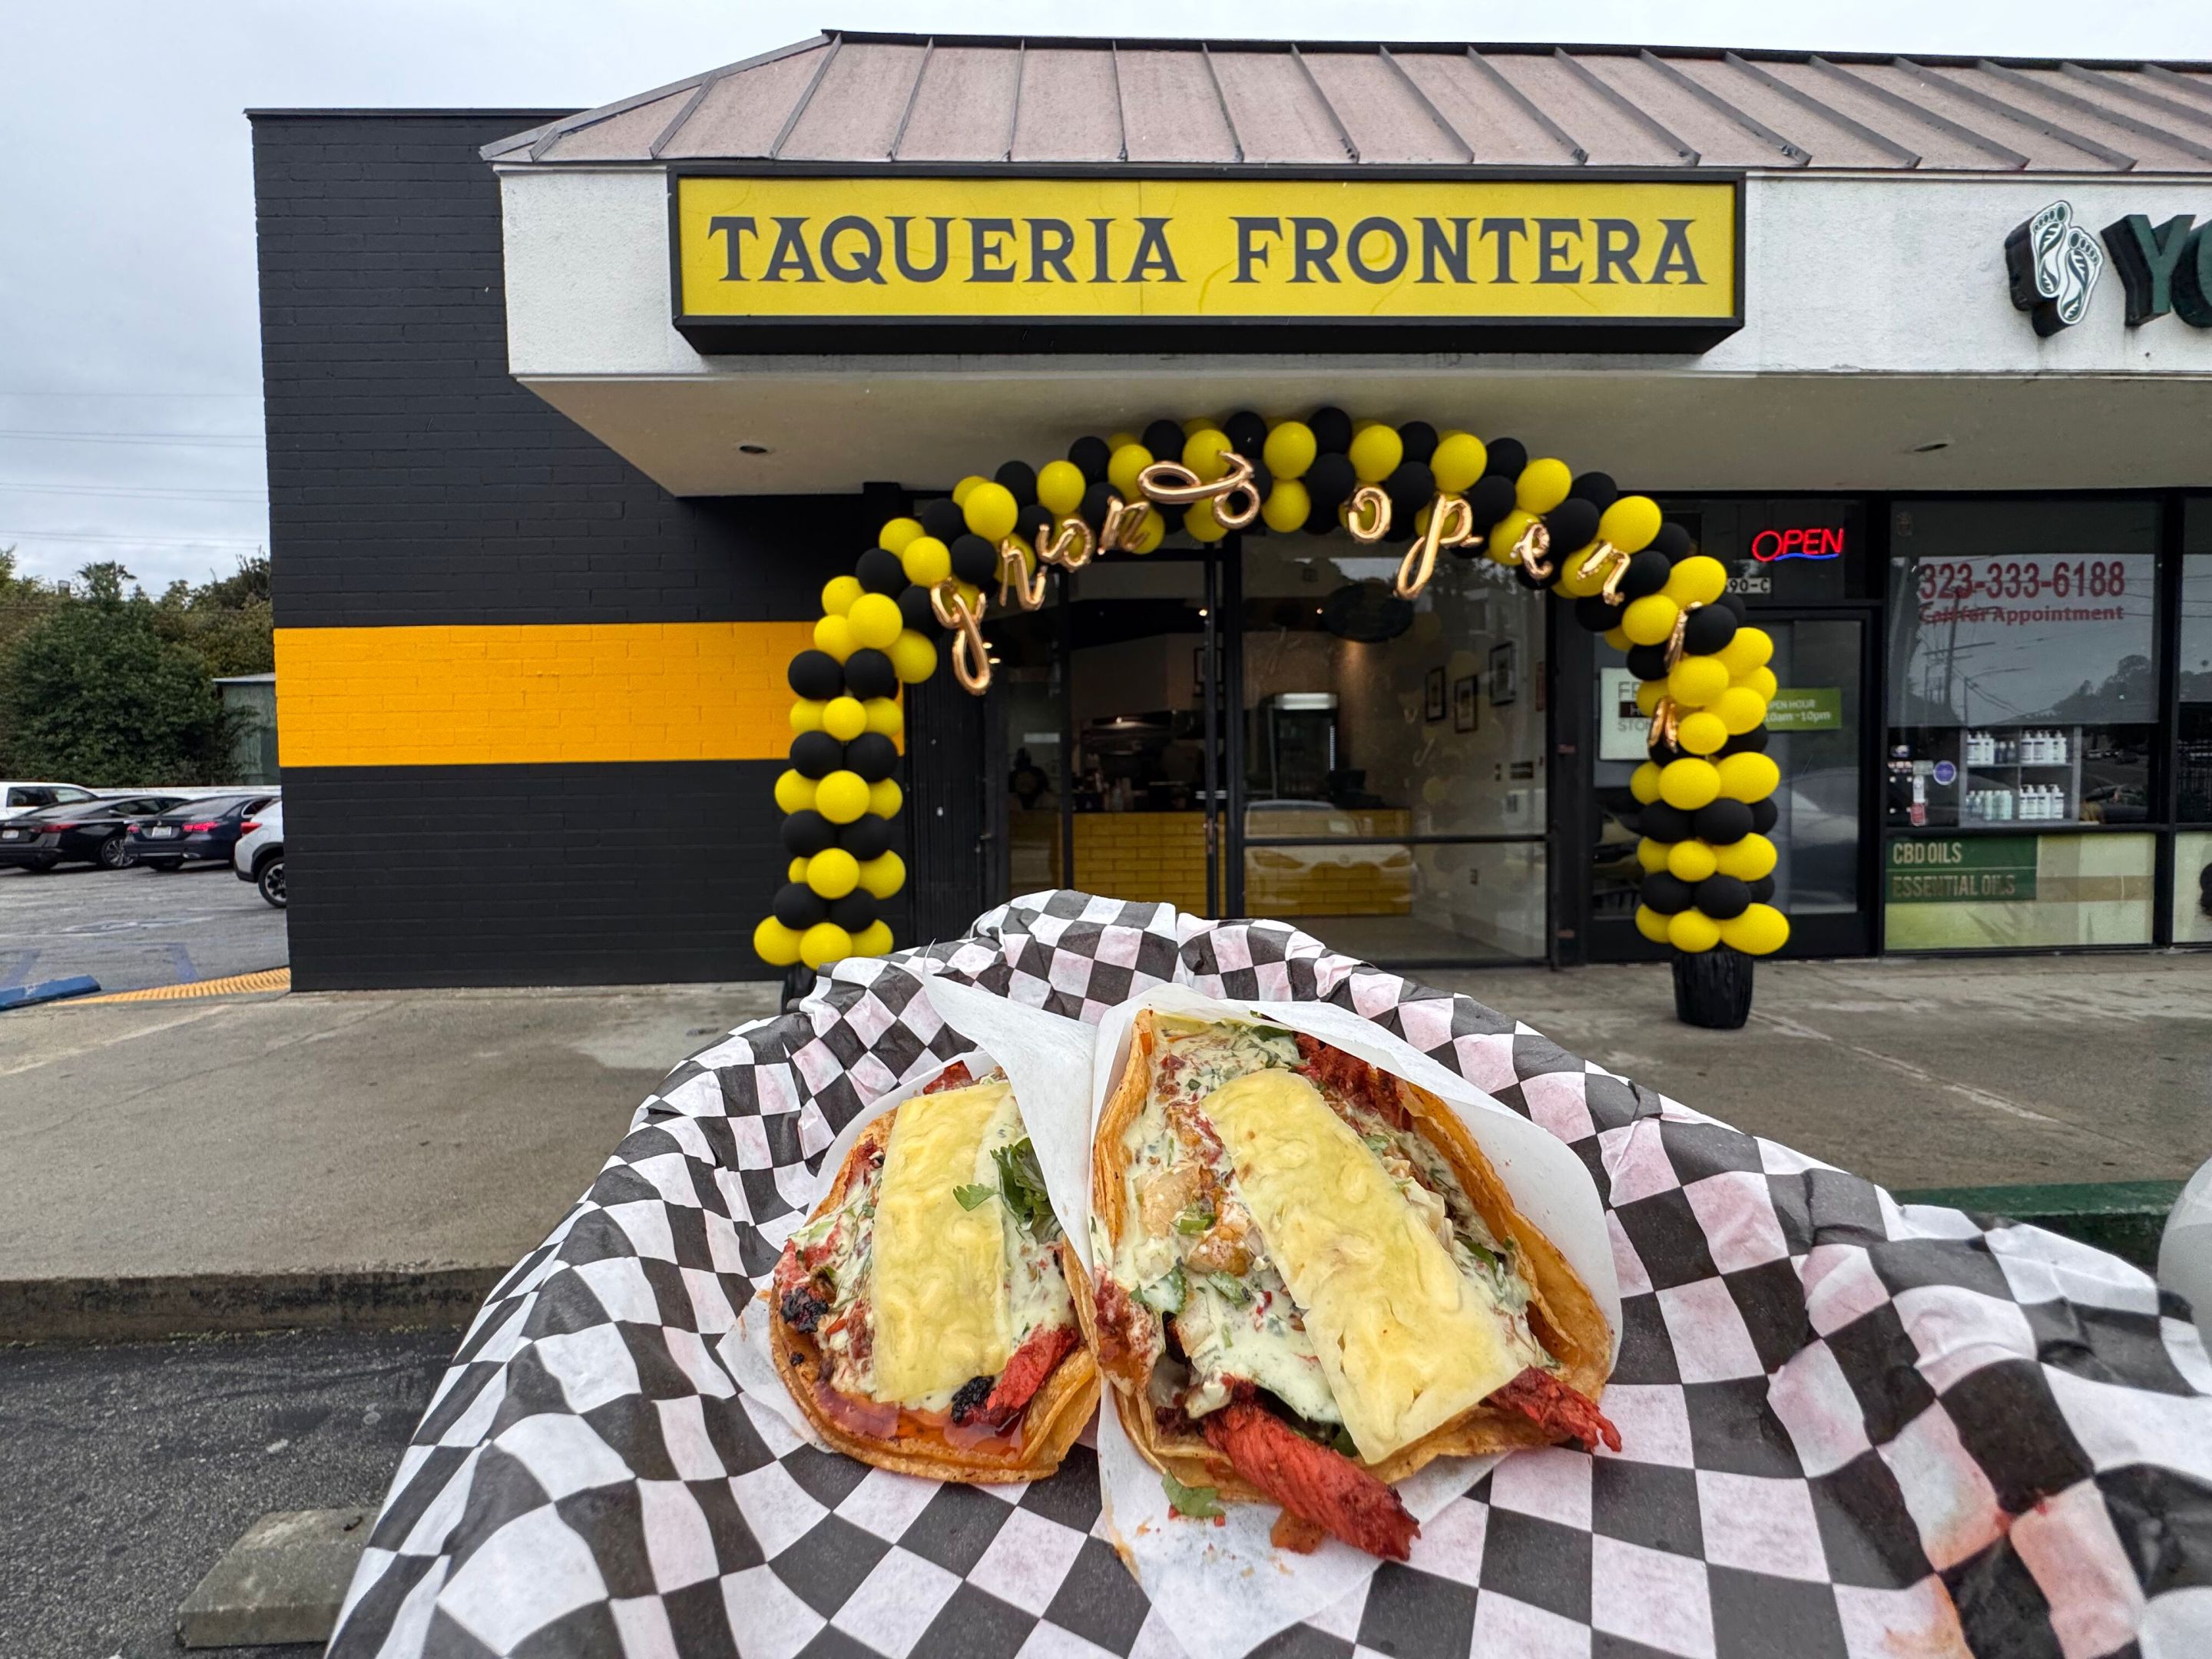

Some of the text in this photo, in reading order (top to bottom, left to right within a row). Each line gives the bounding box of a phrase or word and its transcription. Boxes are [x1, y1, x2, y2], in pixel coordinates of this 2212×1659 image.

[707, 215, 1709, 285] TAQUERIA FRONTERA
[1752, 528, 1843, 562] OPEN
[1920, 561, 2125, 600] 323-333-6188
[1992, 604, 2124, 625] Appointment
[1892, 843, 1962, 865] CBD OILS
[1892, 874, 2016, 898] ESSENTIAL OILS
